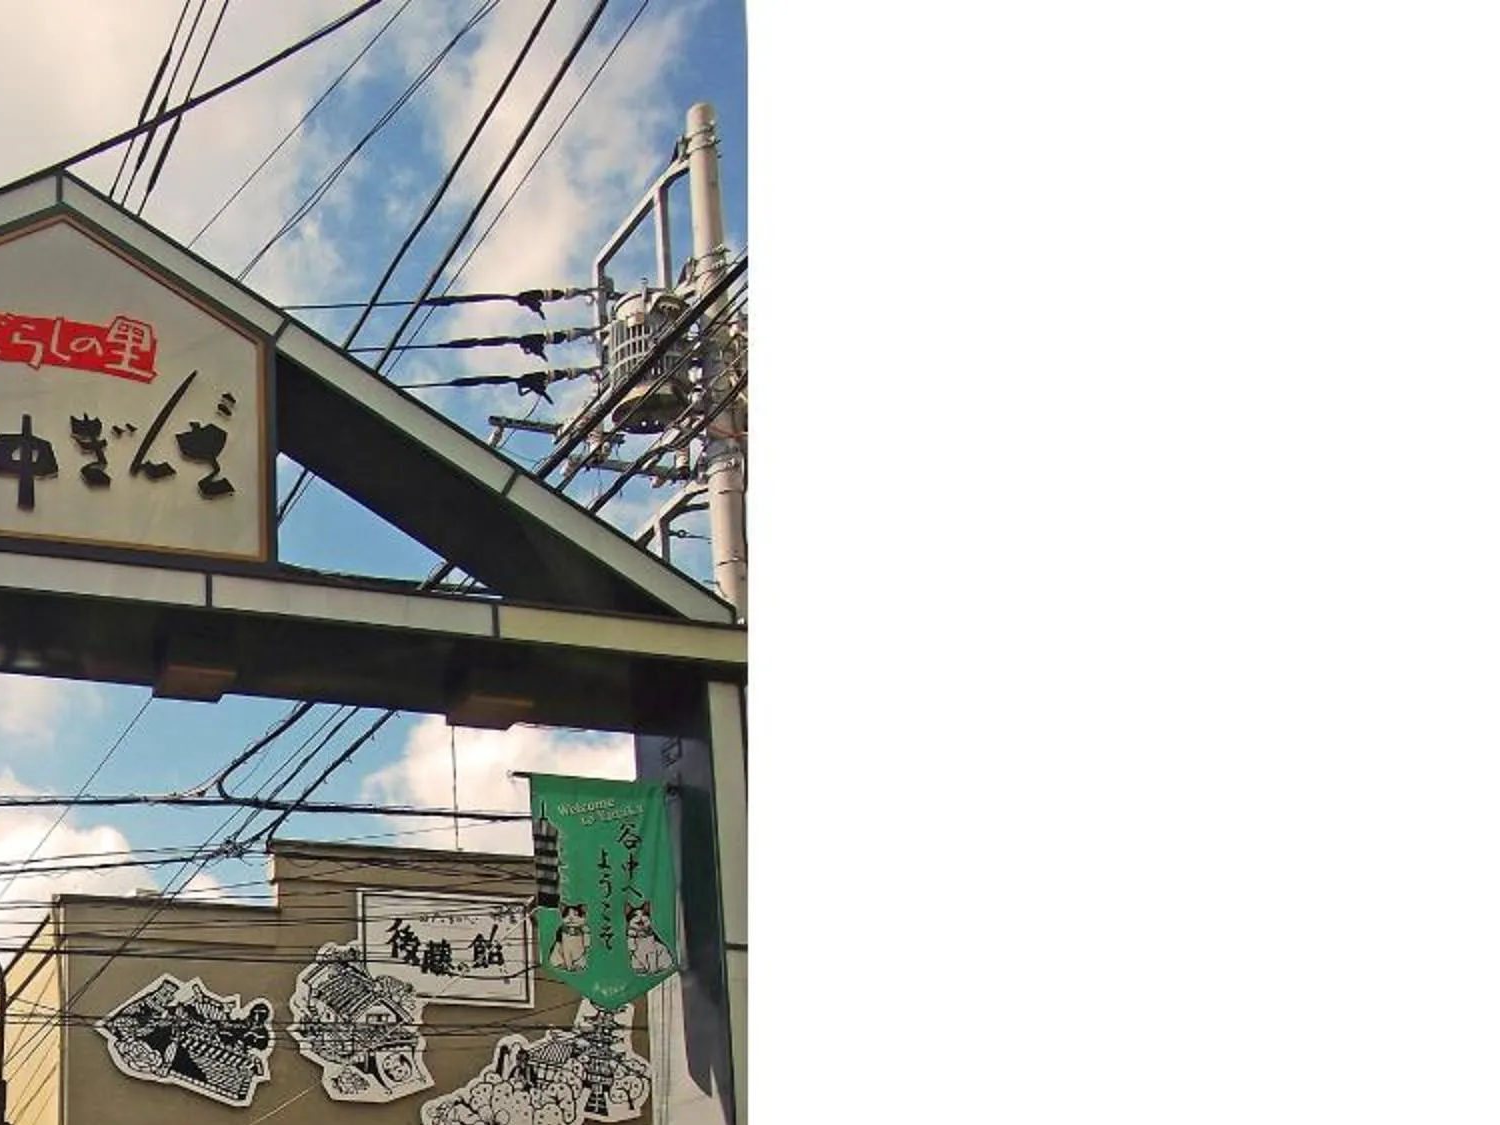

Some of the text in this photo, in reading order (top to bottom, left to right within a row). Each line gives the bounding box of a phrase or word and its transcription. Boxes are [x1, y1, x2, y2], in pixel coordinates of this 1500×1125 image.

[558, 799, 615, 816] Welcome
[581, 804, 644, 826] to Yanaka
[618, 822, 644, 899] 谷中へ
[598, 848, 613, 951] ようこそ
